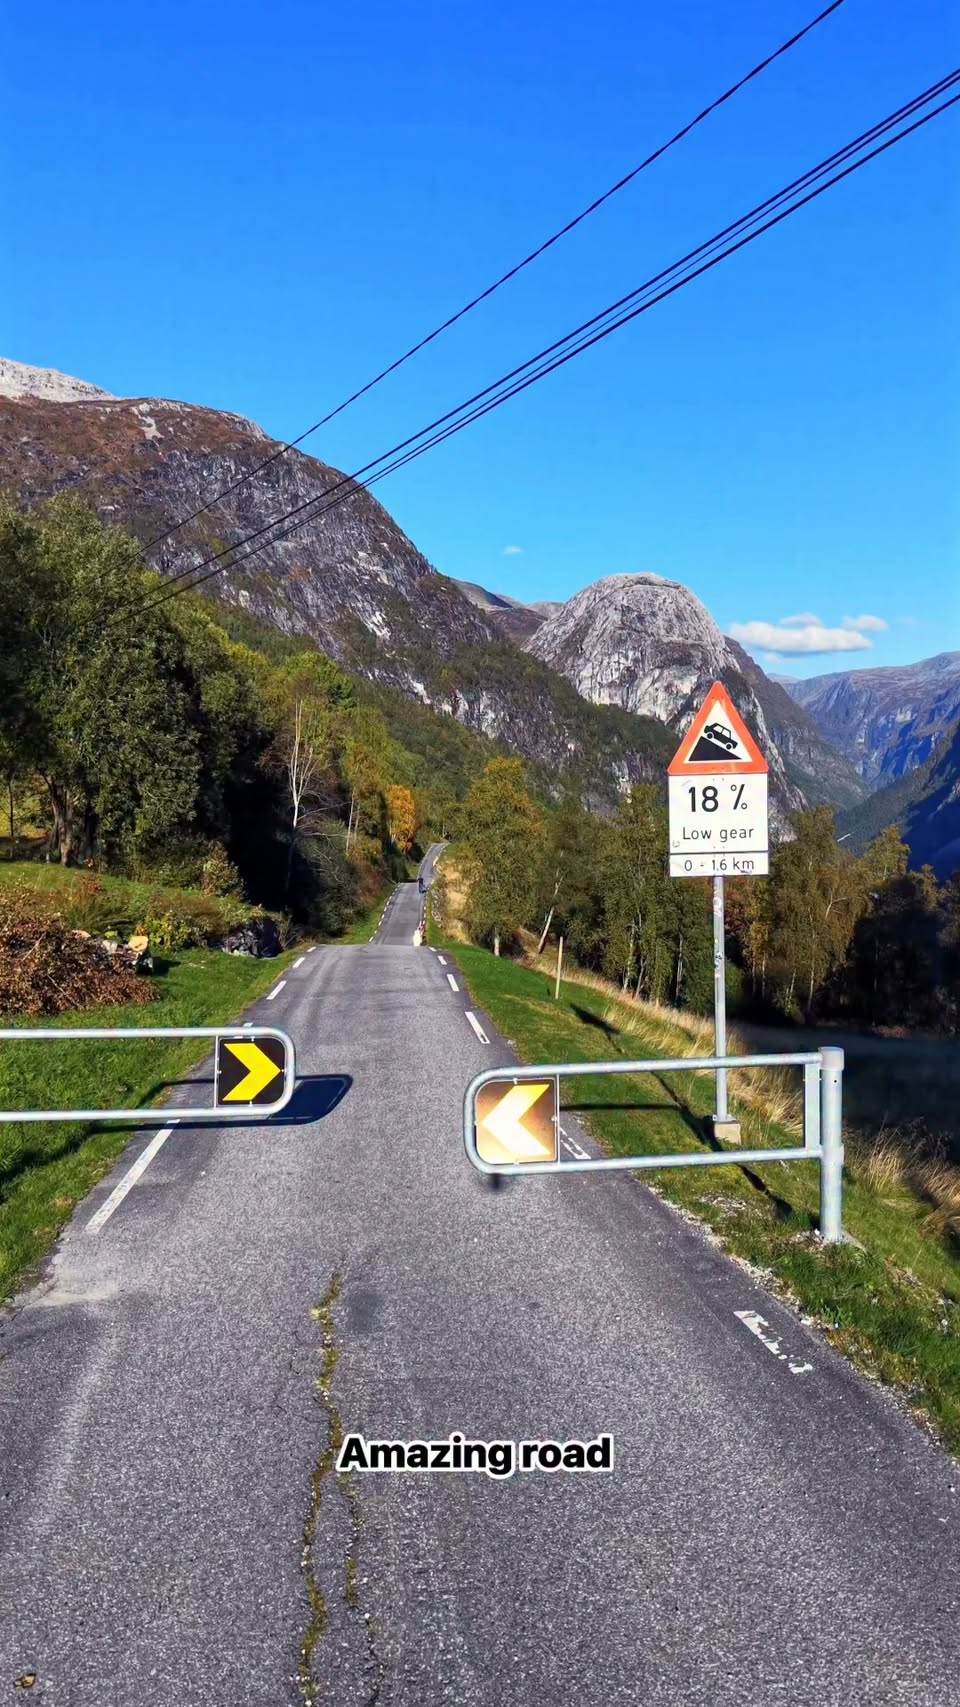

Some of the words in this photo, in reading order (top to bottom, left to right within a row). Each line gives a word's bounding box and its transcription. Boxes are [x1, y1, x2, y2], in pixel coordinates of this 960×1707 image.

[688, 786, 719, 812] 18
[730, 784, 748, 810] %
[682, 826, 712, 840] Low
[719, 828, 754, 843] gear
[684, 859, 693, 871] 0
[732, 856, 755, 870] km
